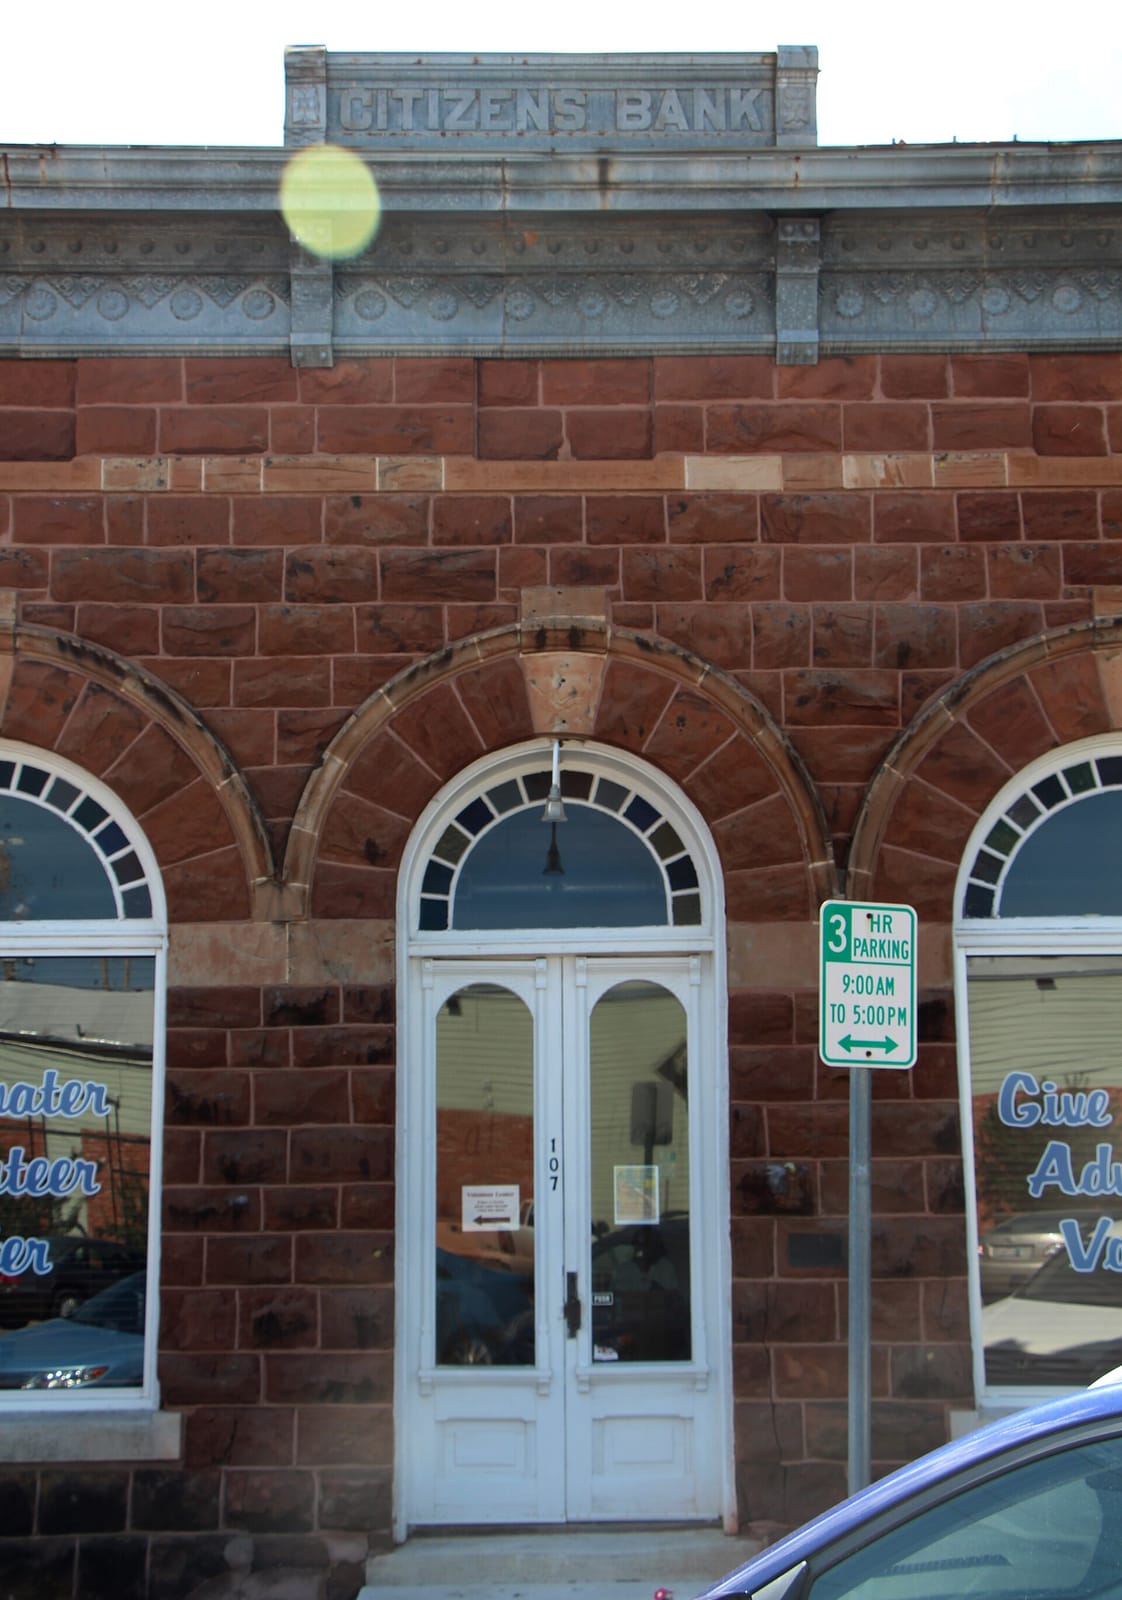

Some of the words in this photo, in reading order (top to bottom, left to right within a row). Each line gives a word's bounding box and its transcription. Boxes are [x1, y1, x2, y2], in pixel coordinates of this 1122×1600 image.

[339, 87, 588, 132] CITIZENS
[616, 87, 766, 132] BANK
[827, 913, 848, 954] 3
[869, 914, 893, 934] HR
[853, 937, 909, 960] PARKING
[830, 1003, 846, 1024] TO
[0, 1069, 112, 1119] ater
[997, 1071, 1113, 1128] Give
[0, 1146, 102, 1197] teer
[0, 1236, 54, 1276] er
